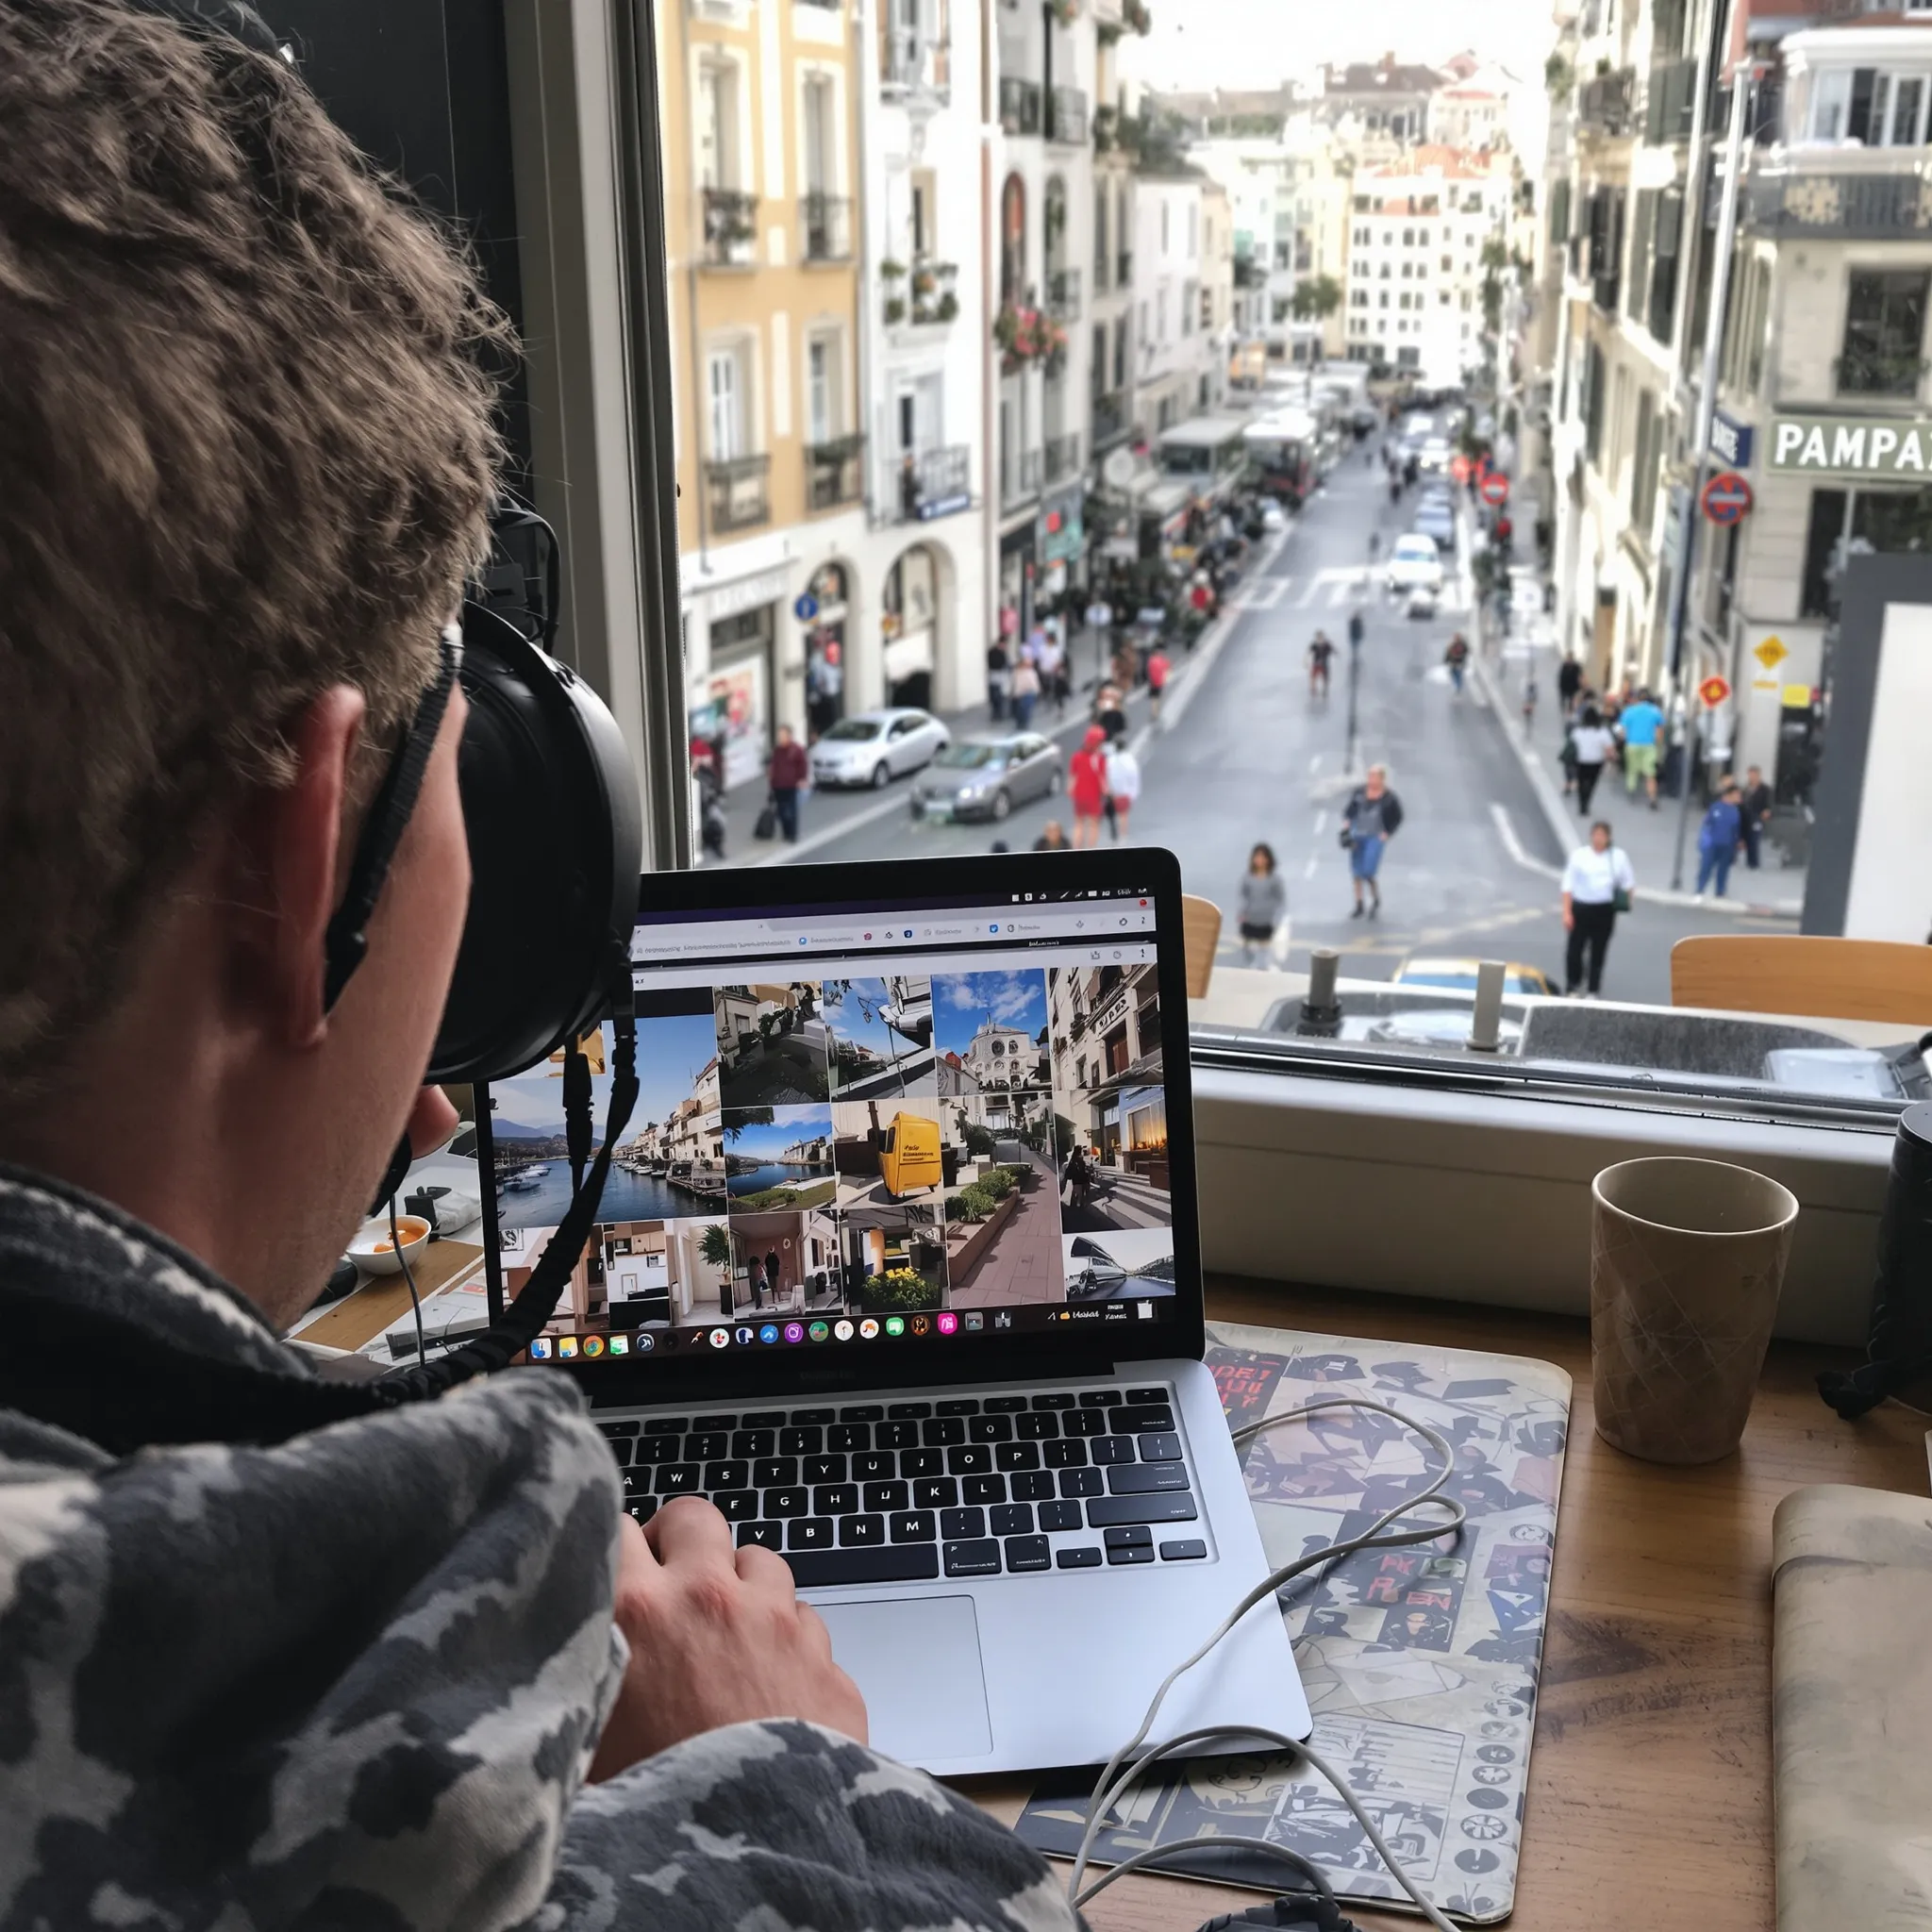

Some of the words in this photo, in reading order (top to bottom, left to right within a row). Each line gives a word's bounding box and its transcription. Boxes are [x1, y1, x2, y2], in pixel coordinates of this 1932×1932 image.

[1774, 424, 1932, 472] PAMPA
[671, 1473, 683, 1483] W
[771, 1467, 780, 1476] T
[820, 1465, 829, 1474] Y
[868, 1461, 877, 1471] U
[964, 1454, 974, 1464] O
[1013, 1452, 1023, 1461] P
[730, 1500, 740, 1509] F
[779, 1496, 790, 1507] G
[830, 1494, 841, 1504] H
[930, 1487, 940, 1497] K
[980, 1483, 989, 1493] L
[755, 1530, 765, 1541] V
[806, 1527, 815, 1538] B
[856, 1524, 866, 1535] N
[906, 1521, 920, 1532] M
